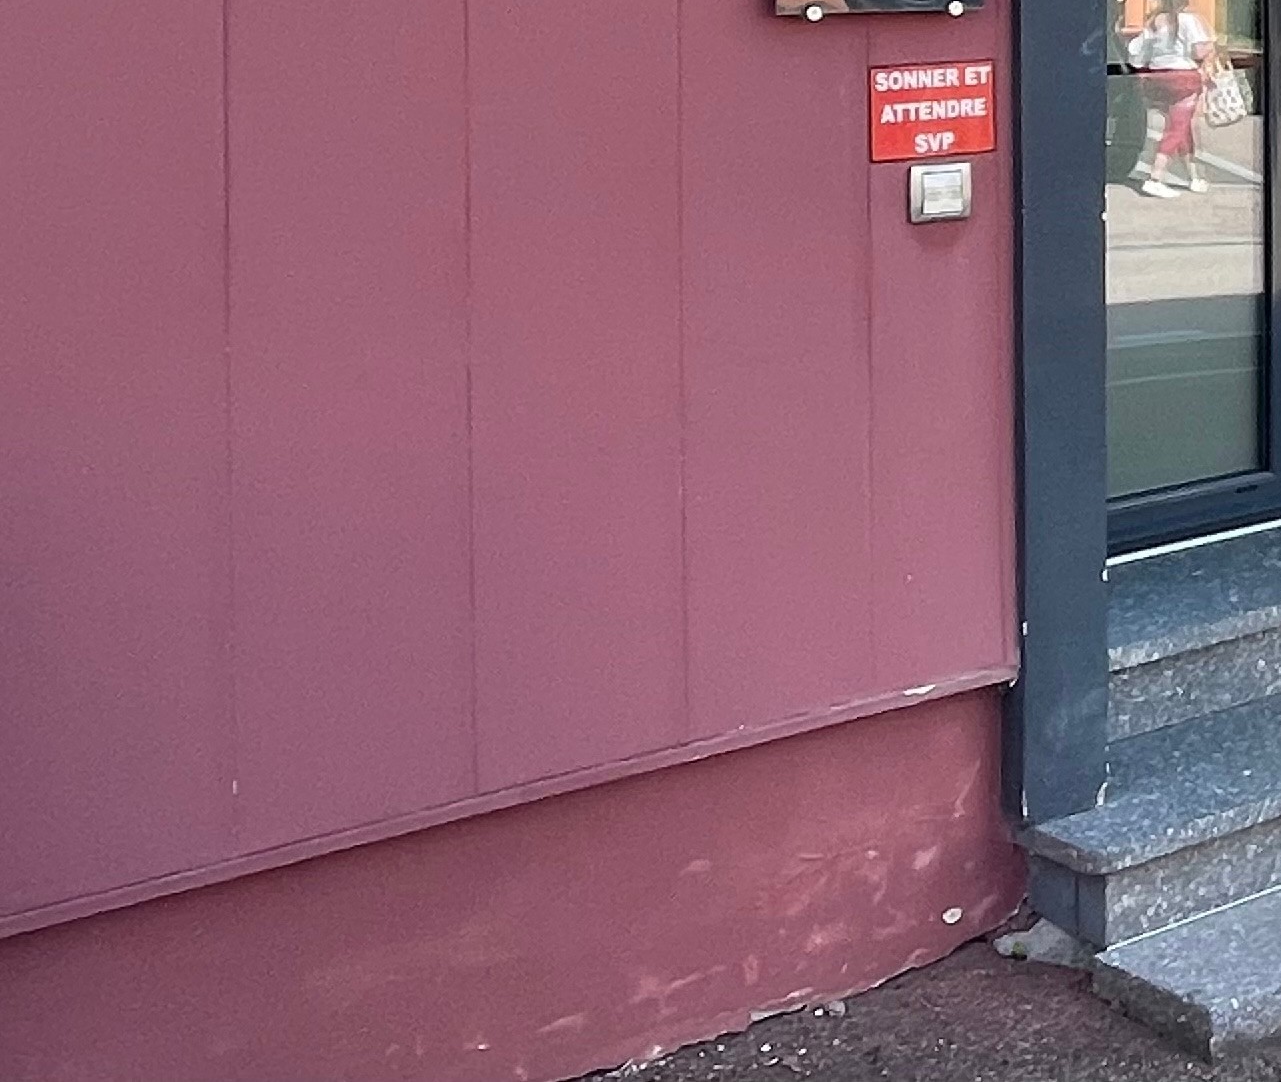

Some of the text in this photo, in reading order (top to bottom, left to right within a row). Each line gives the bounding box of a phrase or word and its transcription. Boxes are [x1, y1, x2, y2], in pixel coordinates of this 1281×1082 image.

[875, 65, 991, 92] SONNER ET
[880, 97, 988, 124] ATTENDRE
[914, 131, 956, 154] SVP
